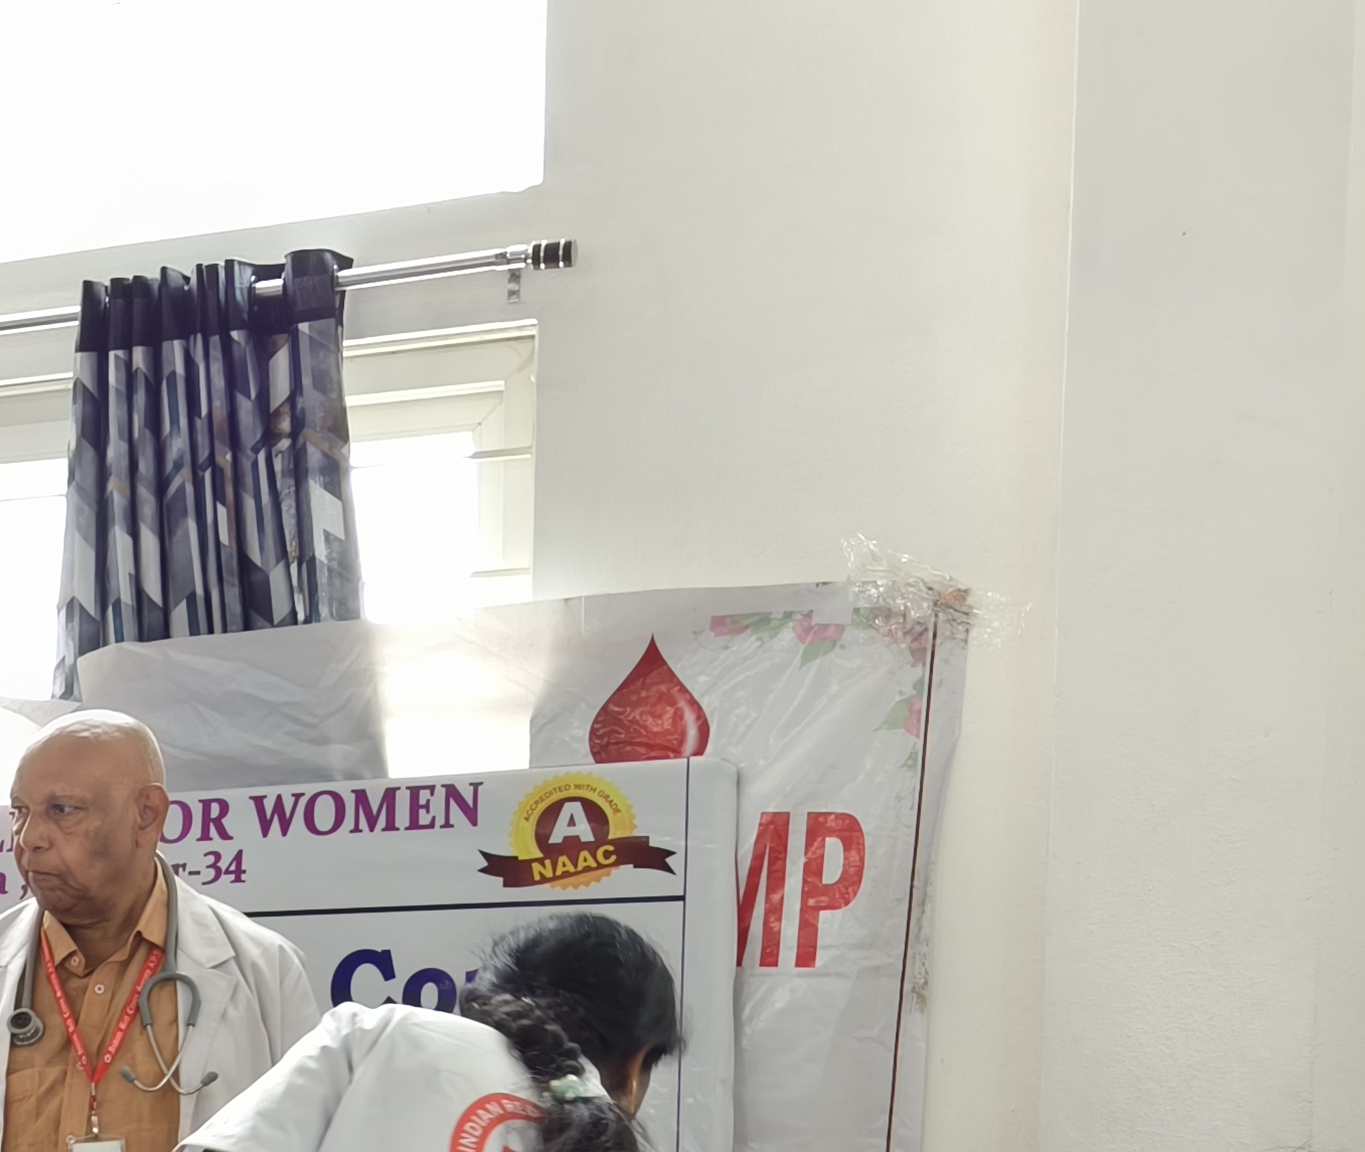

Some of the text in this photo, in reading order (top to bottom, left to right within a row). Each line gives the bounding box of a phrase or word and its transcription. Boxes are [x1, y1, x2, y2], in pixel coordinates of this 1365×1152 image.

[159, 798, 234, 844] OR
[249, 782, 484, 839] WOMEN
[523, 783, 622, 822] ACCREDITED WITH GRADE
[548, 801, 595, 845] A
[531, 844, 617, 881] NAAC
[737, 811, 866, 968] MP
